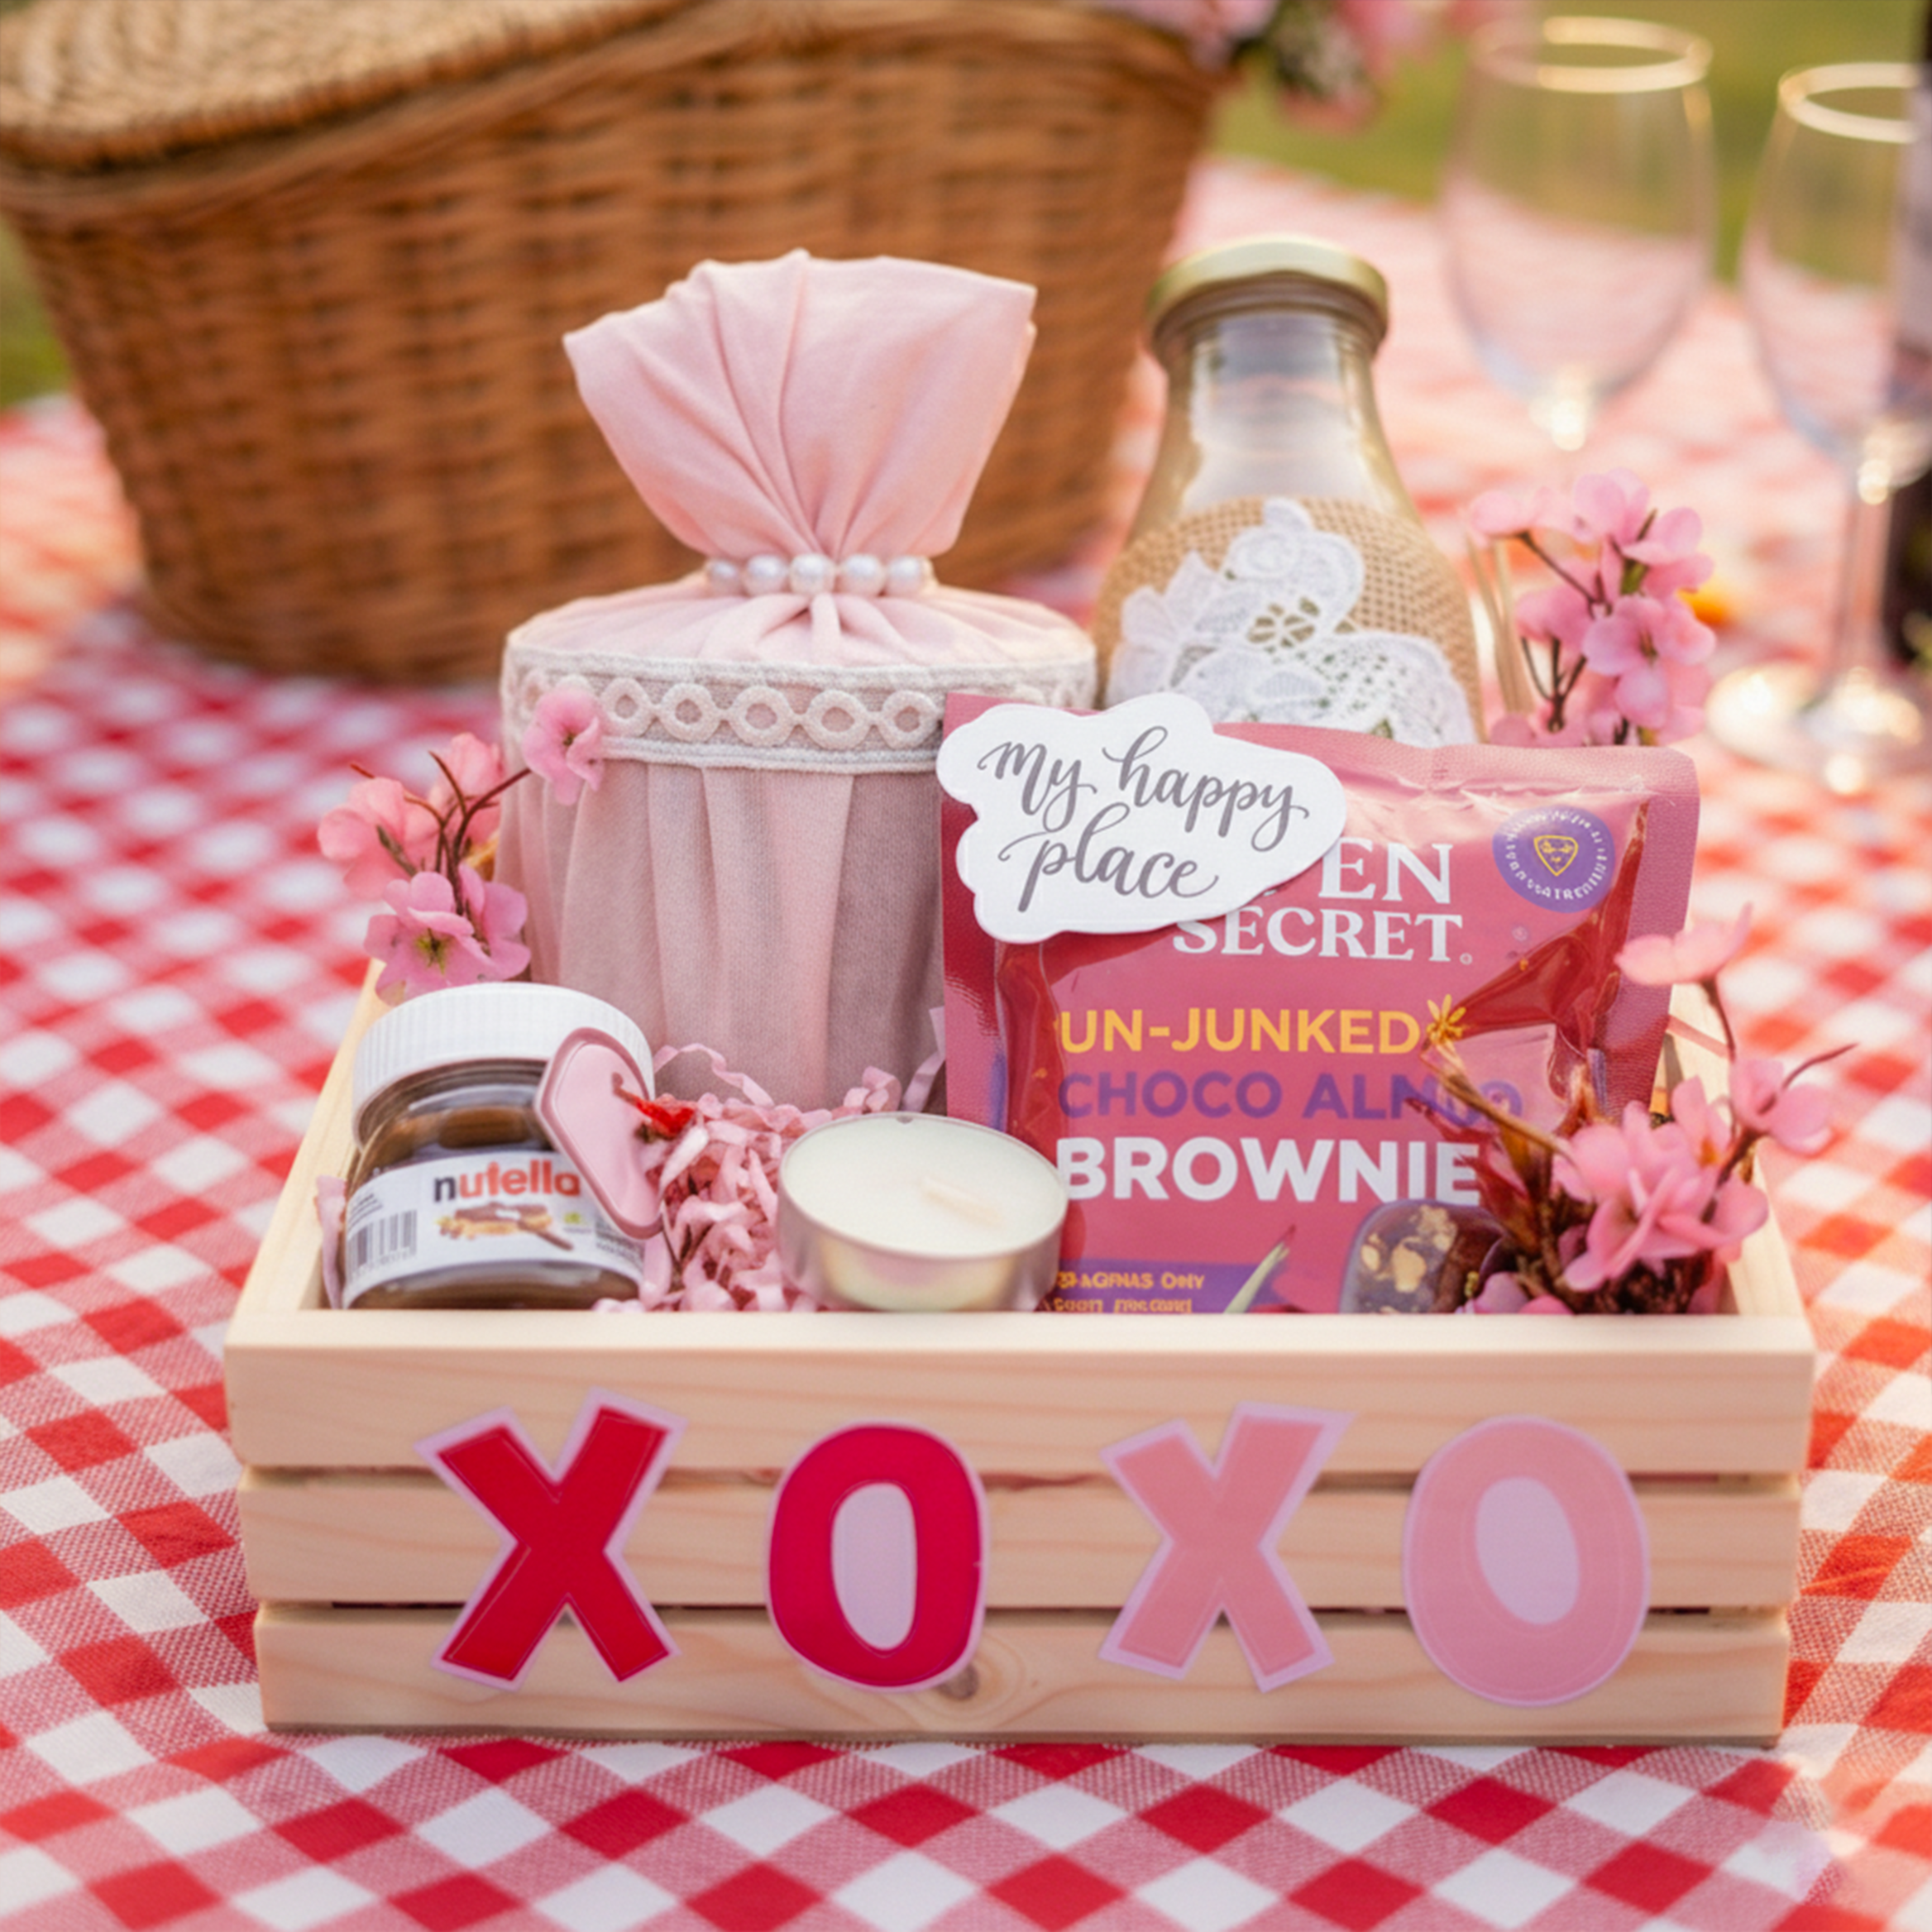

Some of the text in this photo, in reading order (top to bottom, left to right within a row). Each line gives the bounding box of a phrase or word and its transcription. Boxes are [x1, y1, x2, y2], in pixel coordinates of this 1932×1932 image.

[976, 724, 1311, 853] my happy
[997, 801, 1220, 913] place
[1173, 906, 1463, 962] SECRET
[1060, 1007, 1422, 1054] UN-JUNKED
[1058, 1070, 1283, 1120] CHOCO
[434, 1159, 581, 1203] nutella
[1056, 1136, 1480, 1206] BROWNIE
